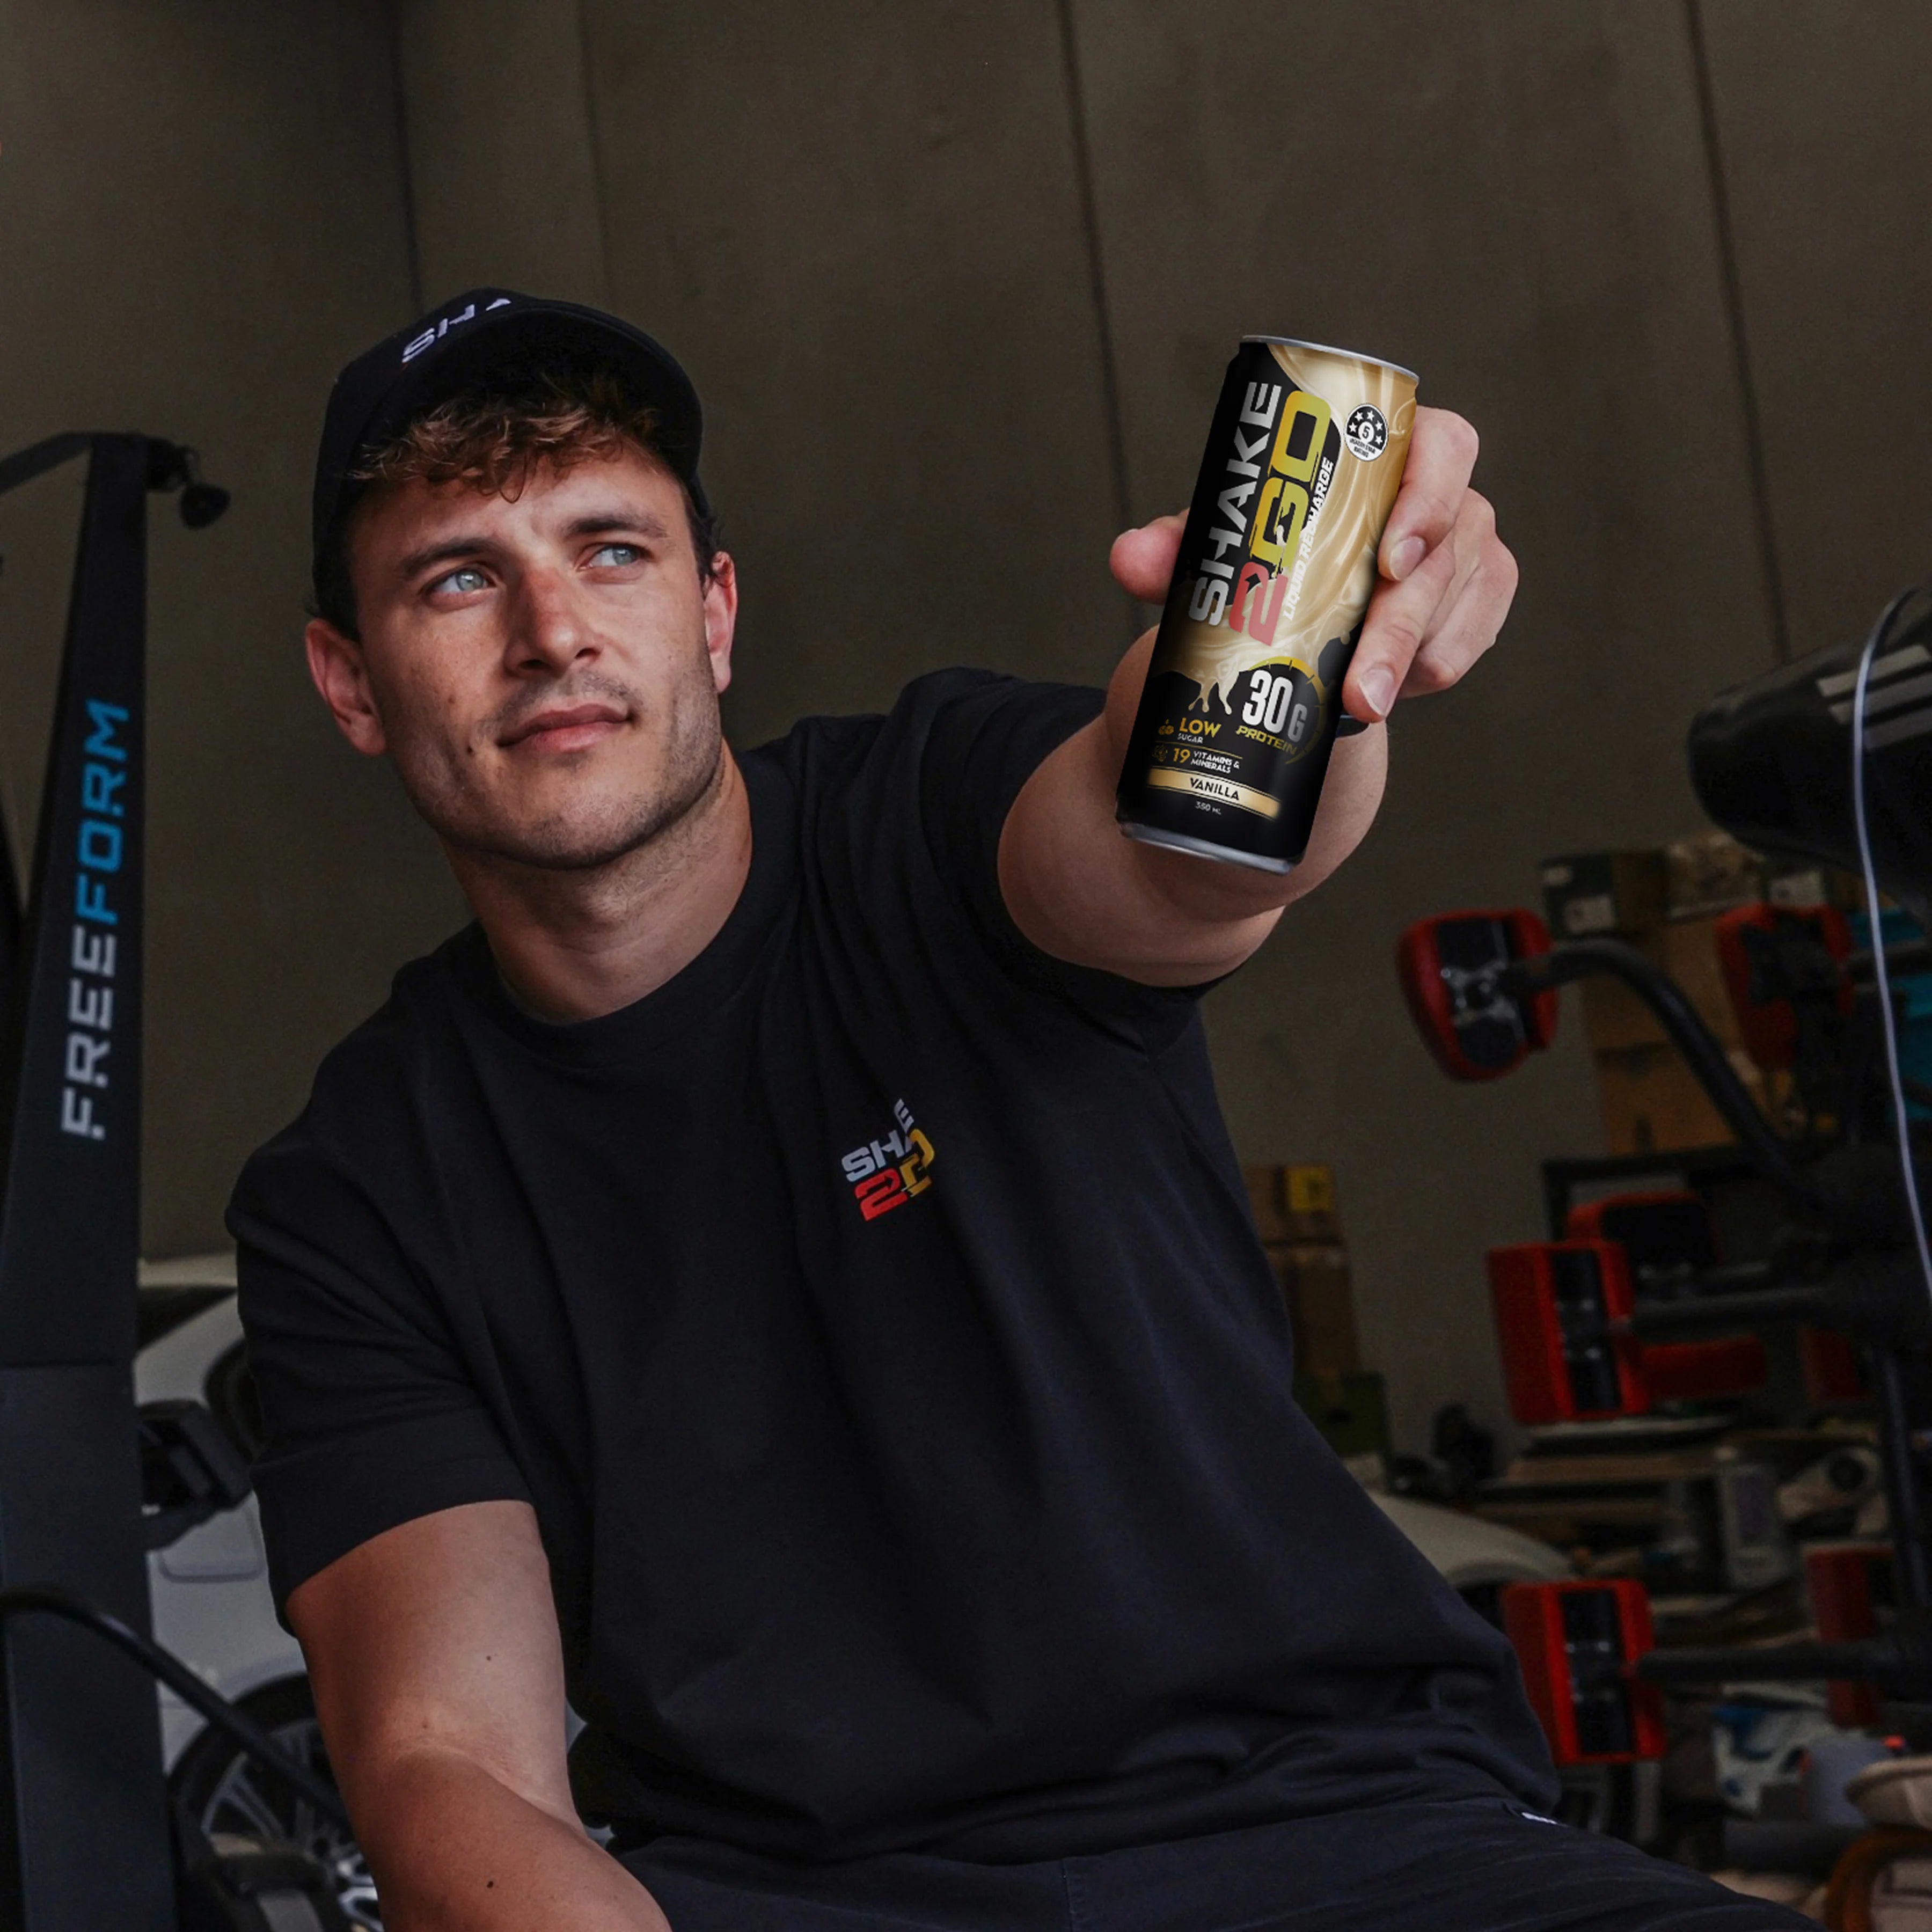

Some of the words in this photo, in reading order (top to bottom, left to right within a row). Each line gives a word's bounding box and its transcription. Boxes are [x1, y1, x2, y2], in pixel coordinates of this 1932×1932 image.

[1362, 426, 1371, 439] 5
[1189, 382, 1282, 626] SHAKE
[1228, 390, 1332, 646] 2GO
[1283, 559, 1307, 621] LIQUID
[1177, 733, 1203, 744] SUGAR
[1179, 717, 1221, 738] LOW
[1235, 725, 1297, 755] PROTEIN
[1173, 748, 1190, 763] 19
[1190, 758, 1231, 774] MINERALS
[1193, 750, 1232, 766] VITAMINS
[1189, 777, 1240, 801] VANILLA
[61, 699, 130, 1141] FREEFORM
